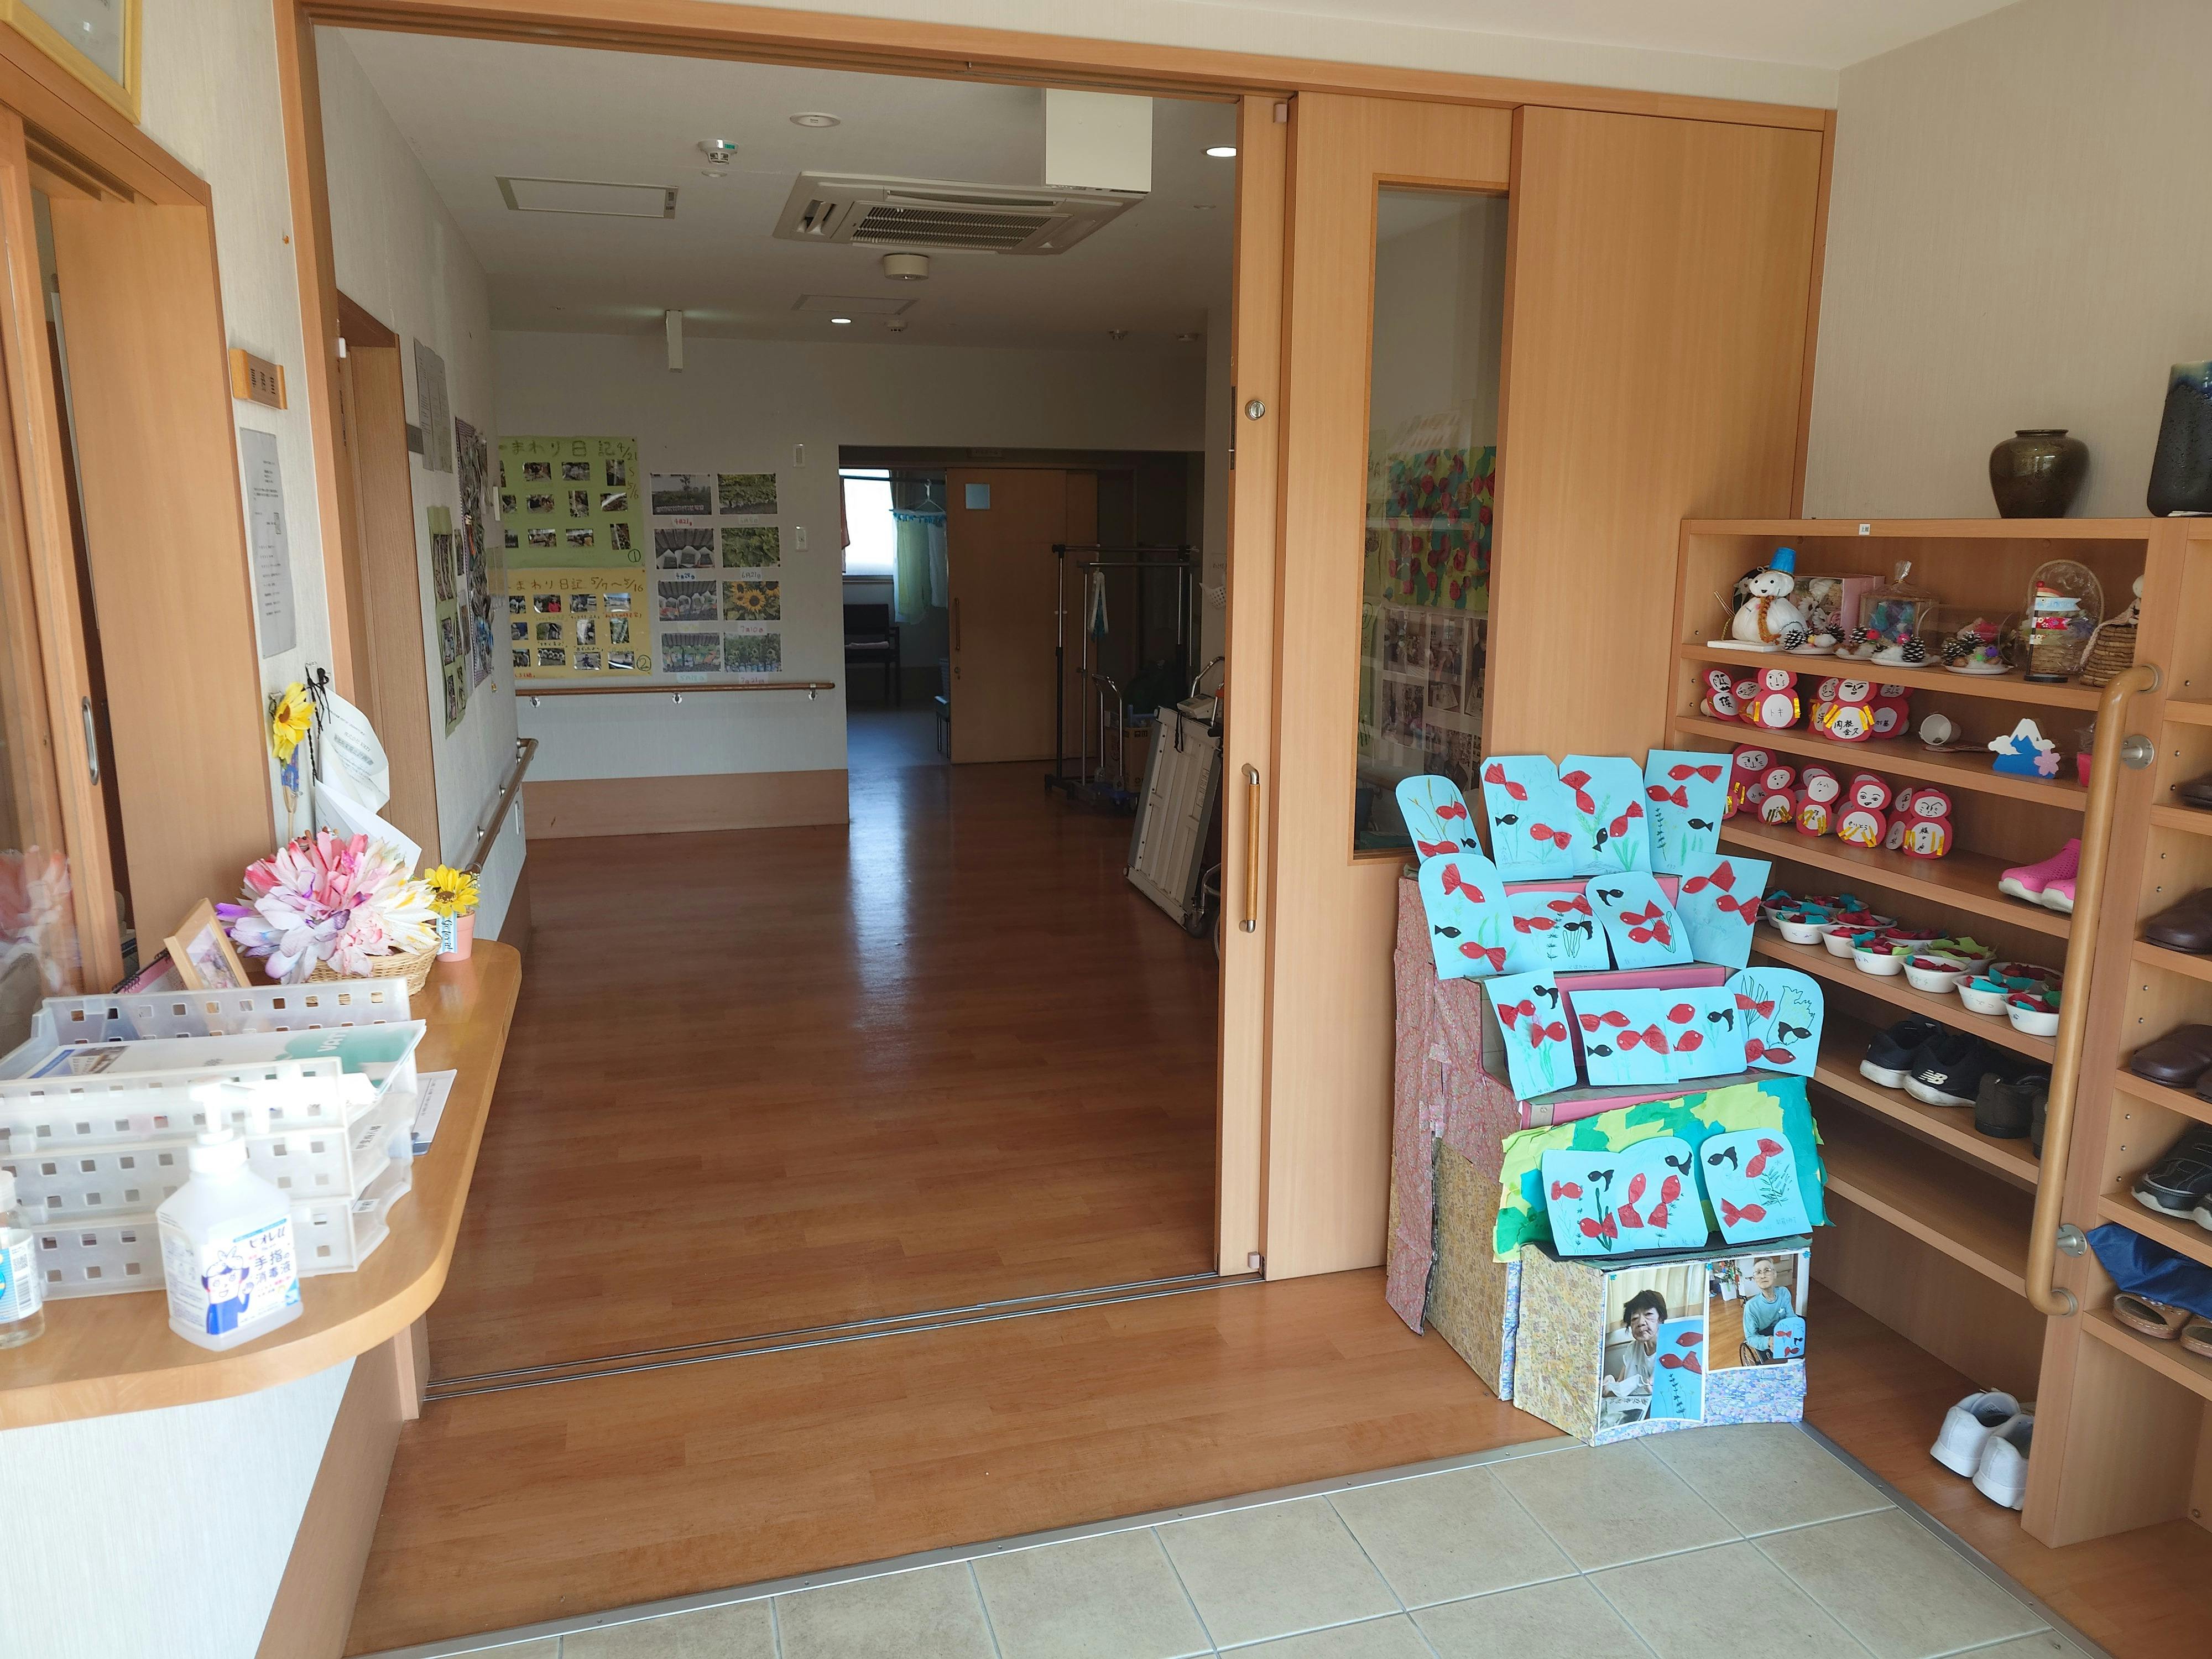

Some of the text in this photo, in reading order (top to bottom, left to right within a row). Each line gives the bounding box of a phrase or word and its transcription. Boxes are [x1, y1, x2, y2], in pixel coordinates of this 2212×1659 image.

[507, 578, 586, 591] まわり日記
[254, 1249, 290, 1270] 手指の
[256, 1261, 292, 1285] 消毒液
